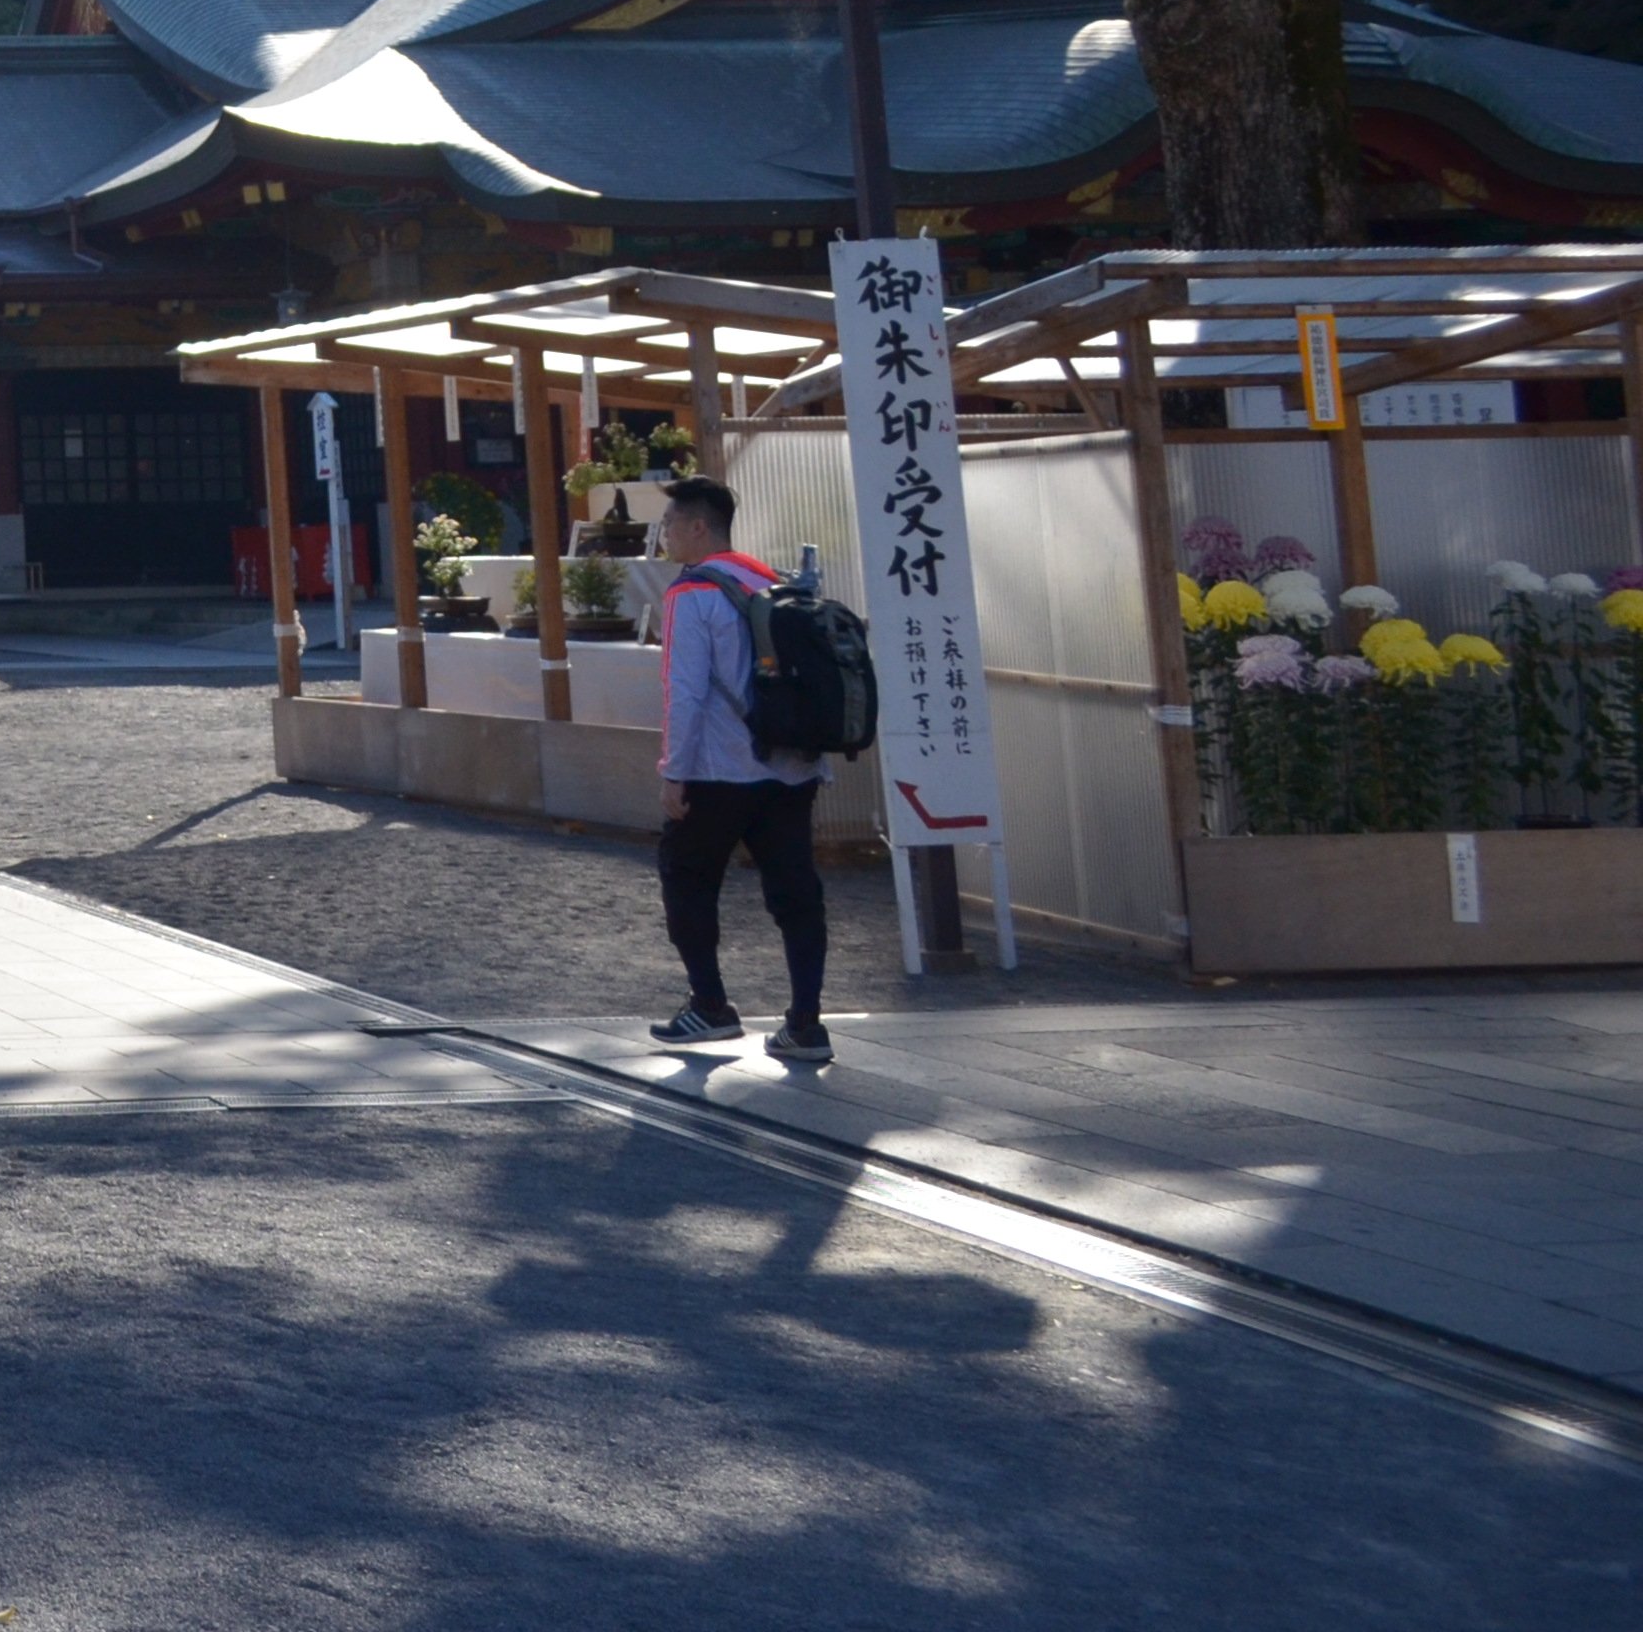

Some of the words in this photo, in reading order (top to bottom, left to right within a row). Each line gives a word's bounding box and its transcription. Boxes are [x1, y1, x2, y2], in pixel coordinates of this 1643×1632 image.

[856, 254, 947, 598] 御朱印受付
[904, 616, 937, 758] お預け下さい
[942, 615, 972, 755] ご参拝の前に
